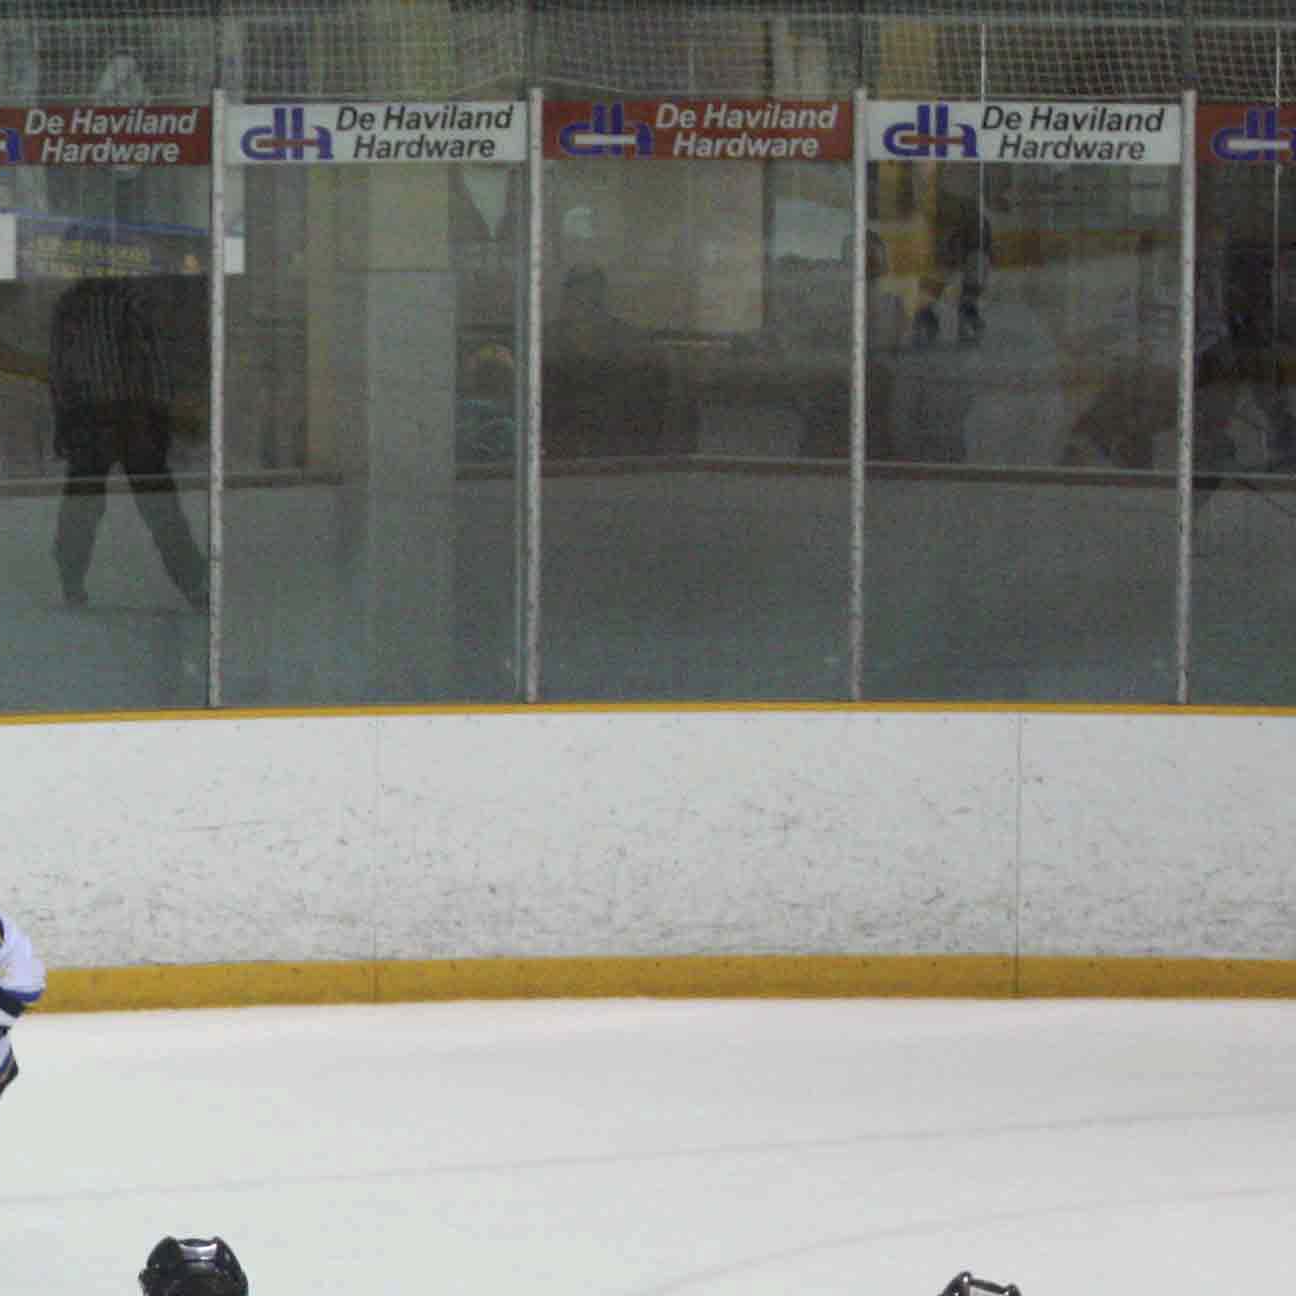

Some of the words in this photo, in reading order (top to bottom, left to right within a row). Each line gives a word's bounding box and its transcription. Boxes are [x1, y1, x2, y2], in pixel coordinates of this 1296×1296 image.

[24, 109, 64, 136] De
[70, 107, 198, 135] Haviland
[336, 106, 376, 132] De
[383, 104, 514, 130] Haviland
[655, 103, 696, 129] De
[703, 103, 839, 129] Haviland
[981, 105, 1021, 131] De
[1028, 105, 1165, 133] Haviland
[40, 137, 180, 164] Hardware
[353, 134, 496, 160] Hardware
[672, 132, 820, 158] Hardware
[998, 133, 1146, 162] Hardware
